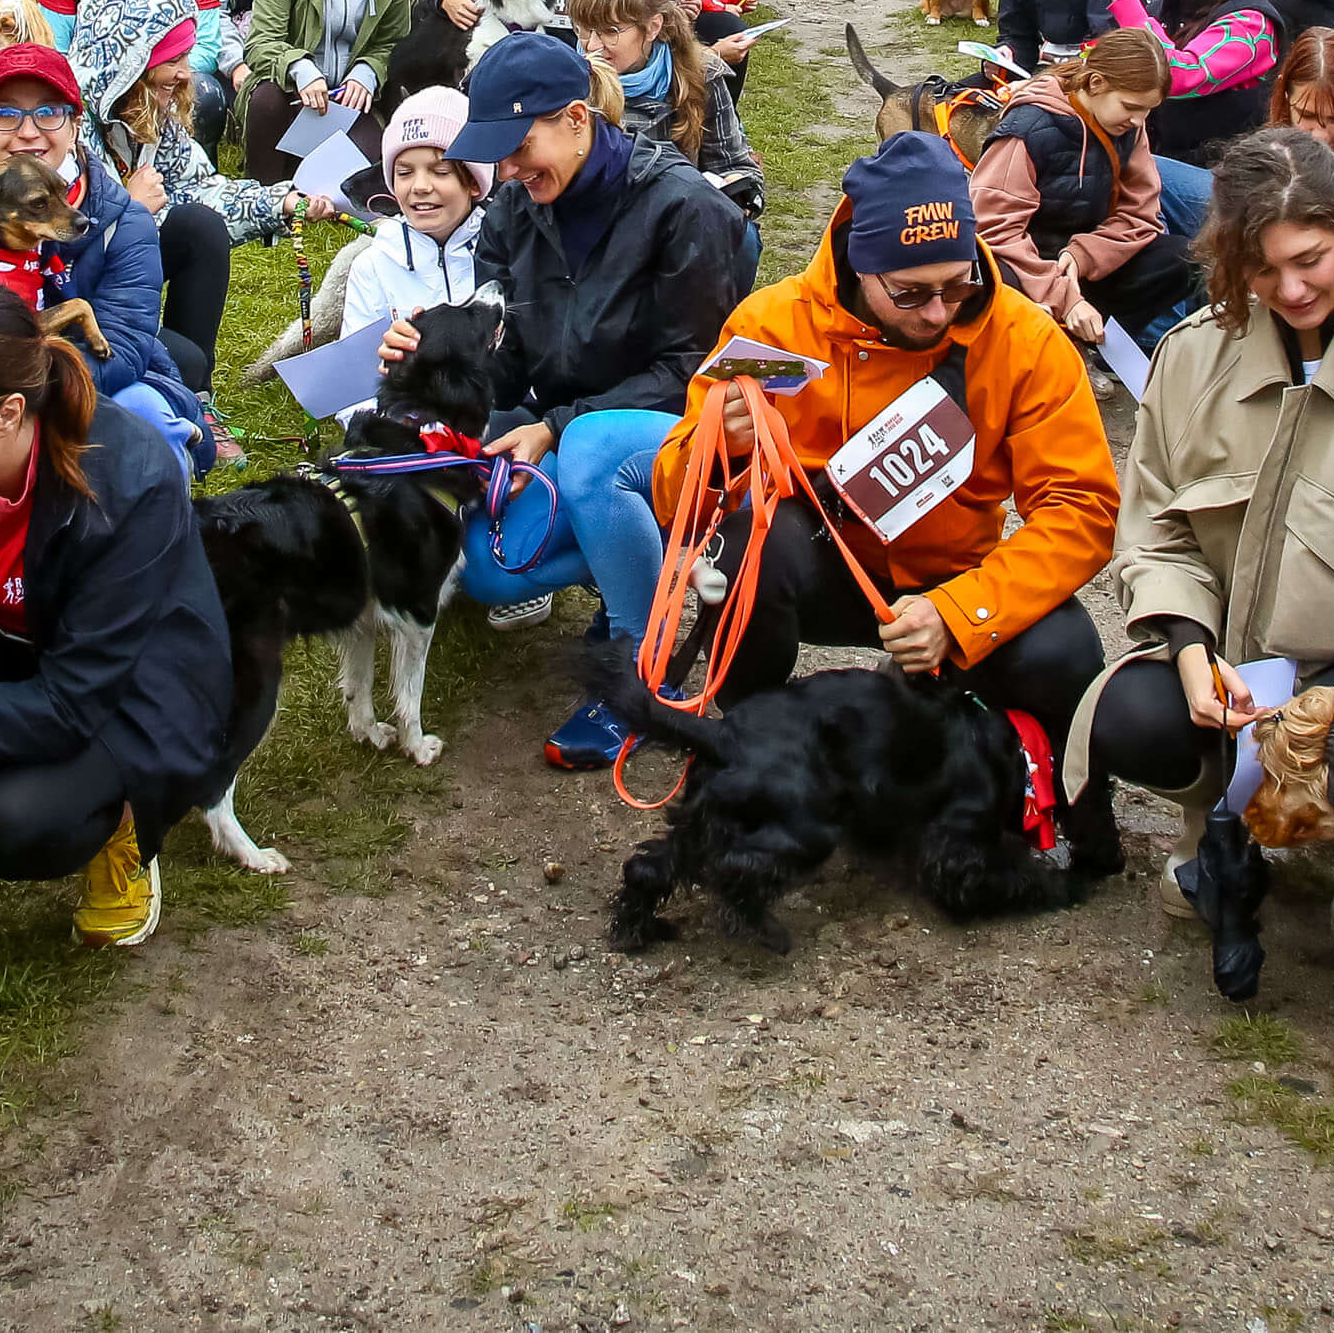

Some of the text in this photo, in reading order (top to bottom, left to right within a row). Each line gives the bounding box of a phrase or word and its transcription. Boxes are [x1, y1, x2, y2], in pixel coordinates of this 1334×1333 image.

[904, 201, 954, 225] FMW
[900, 219, 960, 246] CREW
[869, 422, 951, 499] 1024
